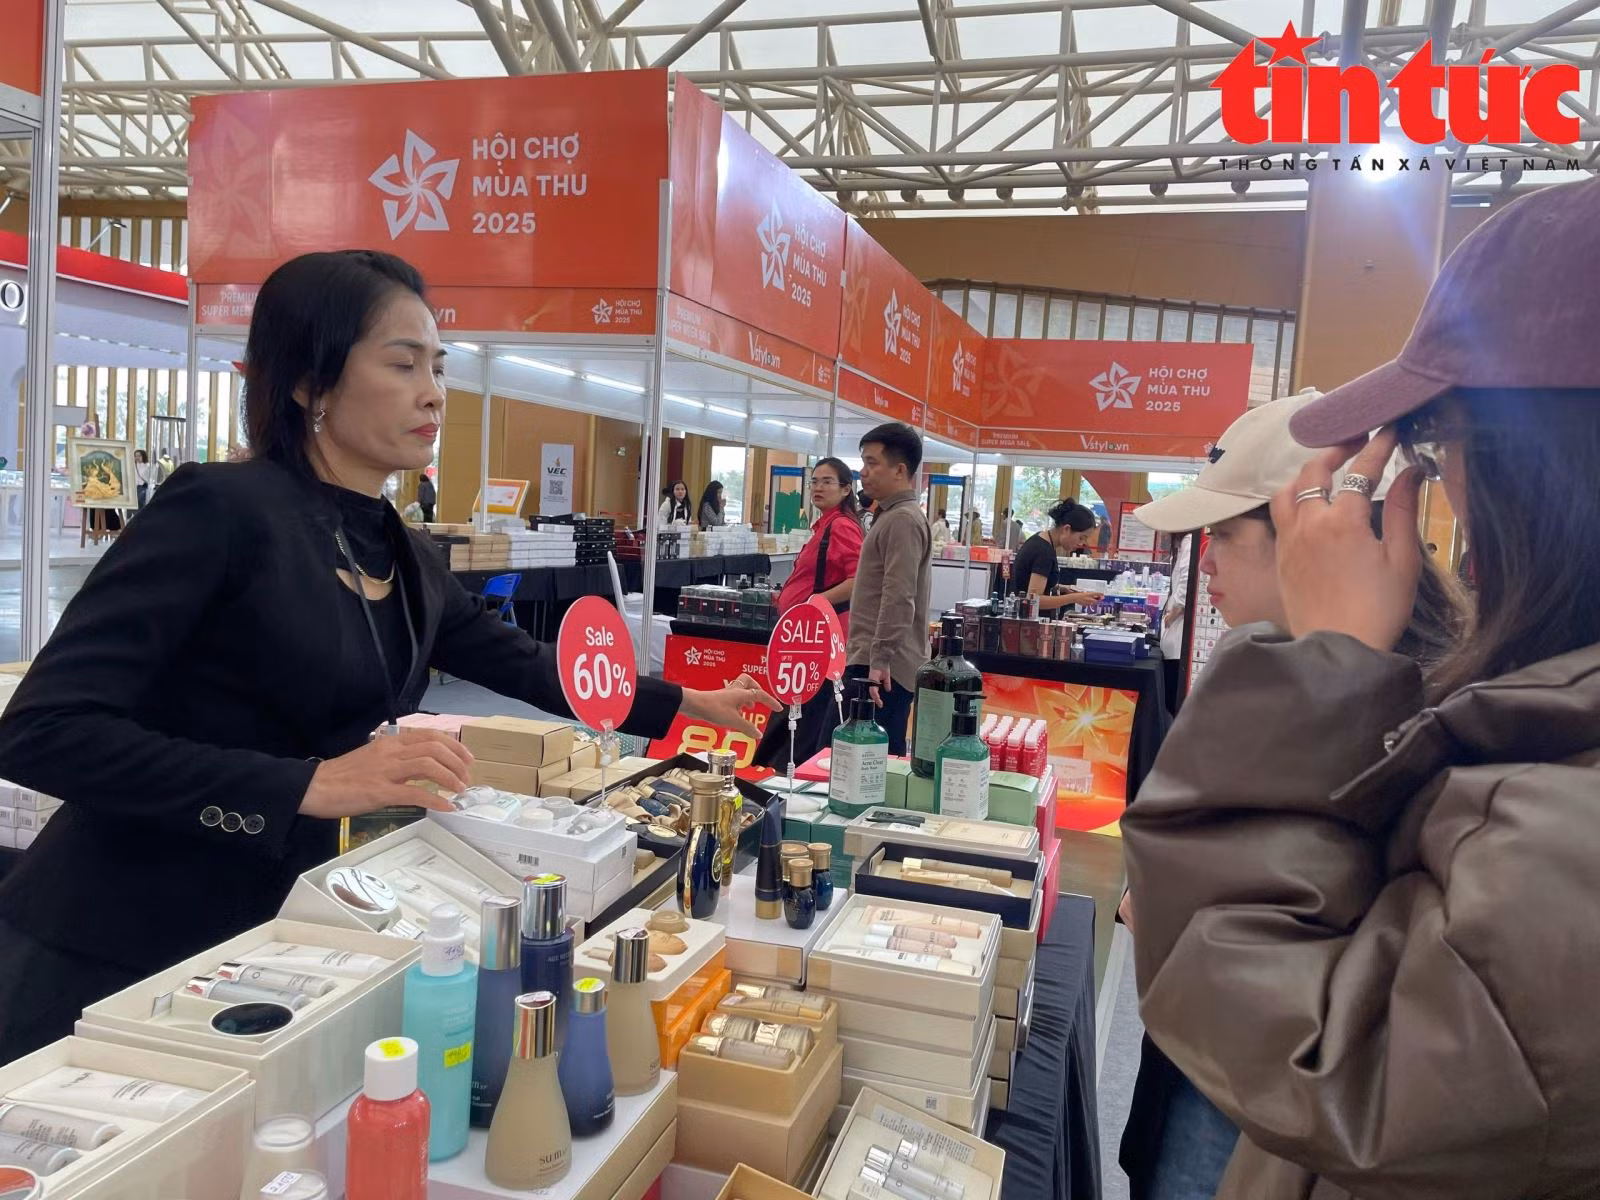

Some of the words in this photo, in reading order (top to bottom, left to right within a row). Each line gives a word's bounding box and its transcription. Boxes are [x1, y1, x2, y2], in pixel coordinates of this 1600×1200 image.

[472, 132, 516, 166] HỘI
[523, 131, 579, 165] CHỢ
[472, 168, 528, 197] MÙA
[536, 174, 587, 196] THU
[472, 212, 536, 234] 2025
[795, 223, 808, 250] HỘI
[810, 235, 826, 262] CHỢ
[793, 252, 810, 278] MÙA
[813, 264, 827, 288] THU
[792, 282, 811, 307] 2025
[1149, 366, 1173, 383] HỘI
[1176, 367, 1208, 383] CHỢ
[1147, 382, 1178, 396] MÙA
[1183, 385, 1211, 397] THU
[1146, 401, 1181, 412] 2025
[547, 467, 567, 475] VEC
[585, 626, 614, 646] Sale
[780, 619, 826, 644] SALE
[573, 652, 631, 700] 60%
[806, 682, 819, 692] OFF
